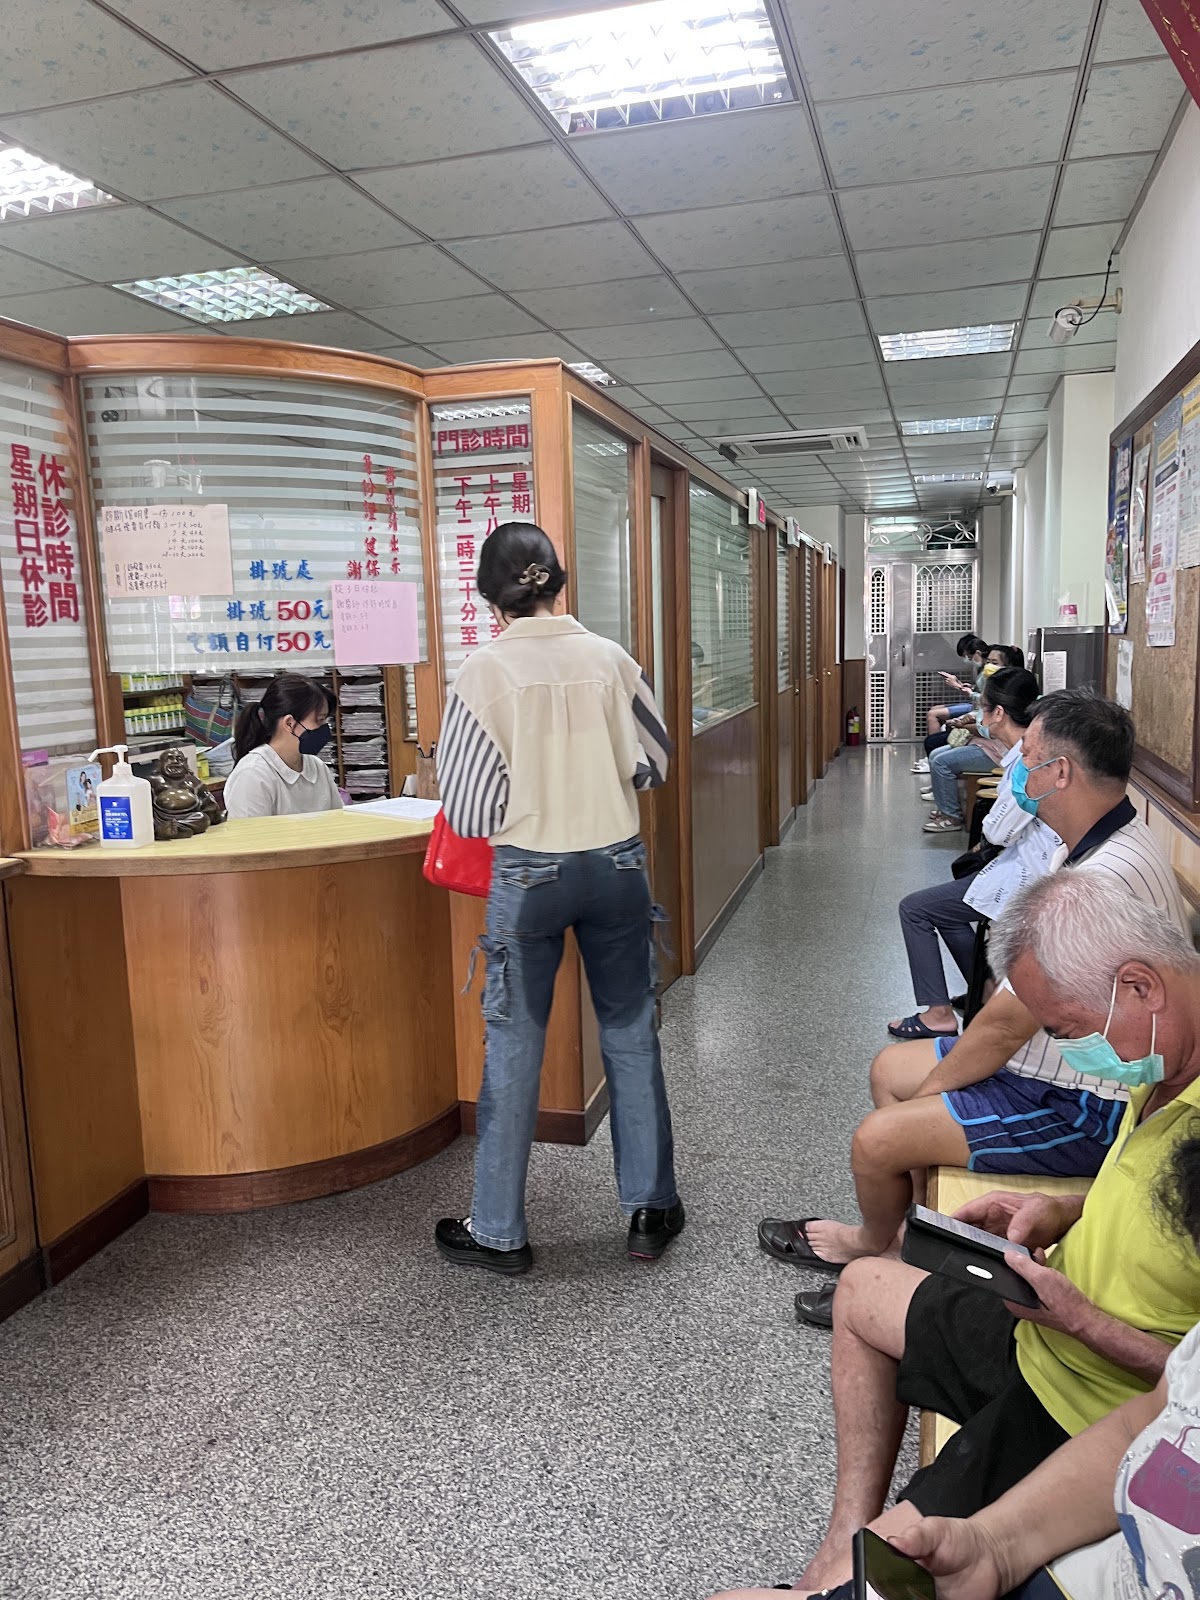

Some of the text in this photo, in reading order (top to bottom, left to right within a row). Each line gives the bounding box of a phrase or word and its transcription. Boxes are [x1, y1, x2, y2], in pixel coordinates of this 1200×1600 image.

[437, 424, 529, 454] 門診時間
[10, 443, 50, 628] 星期日休診
[38, 453, 80, 623] 休診時間
[250, 559, 314, 581] 掛號處
[385, 467, 401, 574] 掛號請出示
